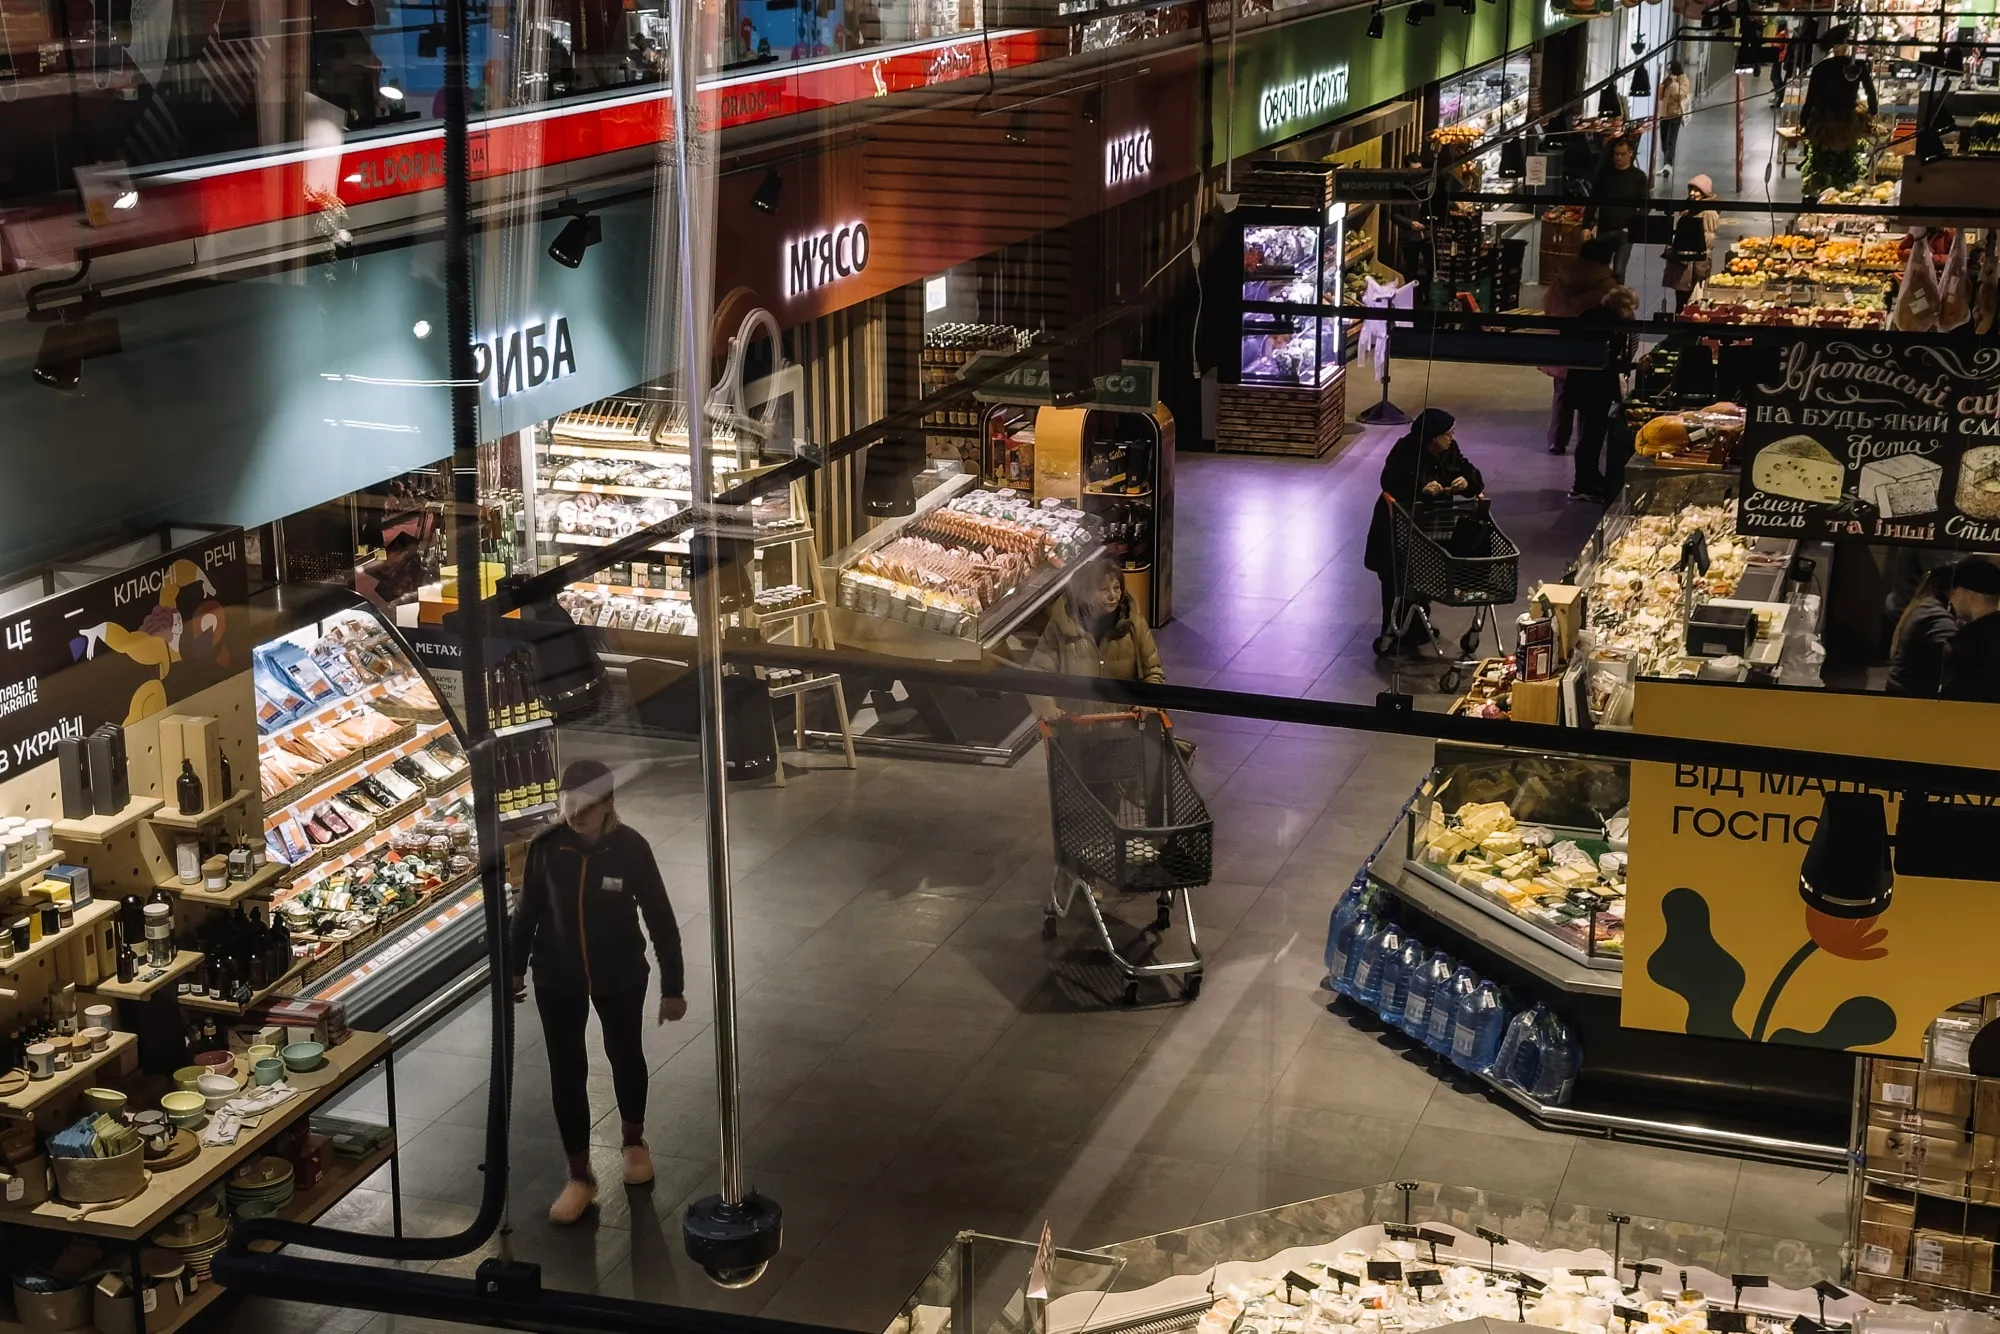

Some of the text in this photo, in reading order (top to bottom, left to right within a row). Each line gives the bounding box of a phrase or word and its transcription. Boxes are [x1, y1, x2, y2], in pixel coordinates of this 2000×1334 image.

[1110, 131, 1156, 184] М'ЯСО
[790, 222, 870, 296] М'ЯСО
[470, 316, 577, 399] РИБА
[1757, 341, 1952, 409] вропейські
[1004, 368, 1050, 387] ИБА
[1802, 407, 1950, 434] БУДЬ-ЯКИЙ
[1959, 417, 2000, 437] см
[1847, 433, 1944, 470] Фета
[1874, 518, 1937, 542] інші
[1945, 515, 2000, 543] Стіл
[5, 618, 33, 651] ЦЕ
[113, 564, 178, 608] КЛАСНІ
[203, 540, 237, 572] РЕЧІ
[27, 675, 38, 692] IN
[13, 715, 84, 766] УКРАЇНІ
[1674, 762, 1745, 799] ВІД
[1671, 805, 1824, 847] ГОСПО
